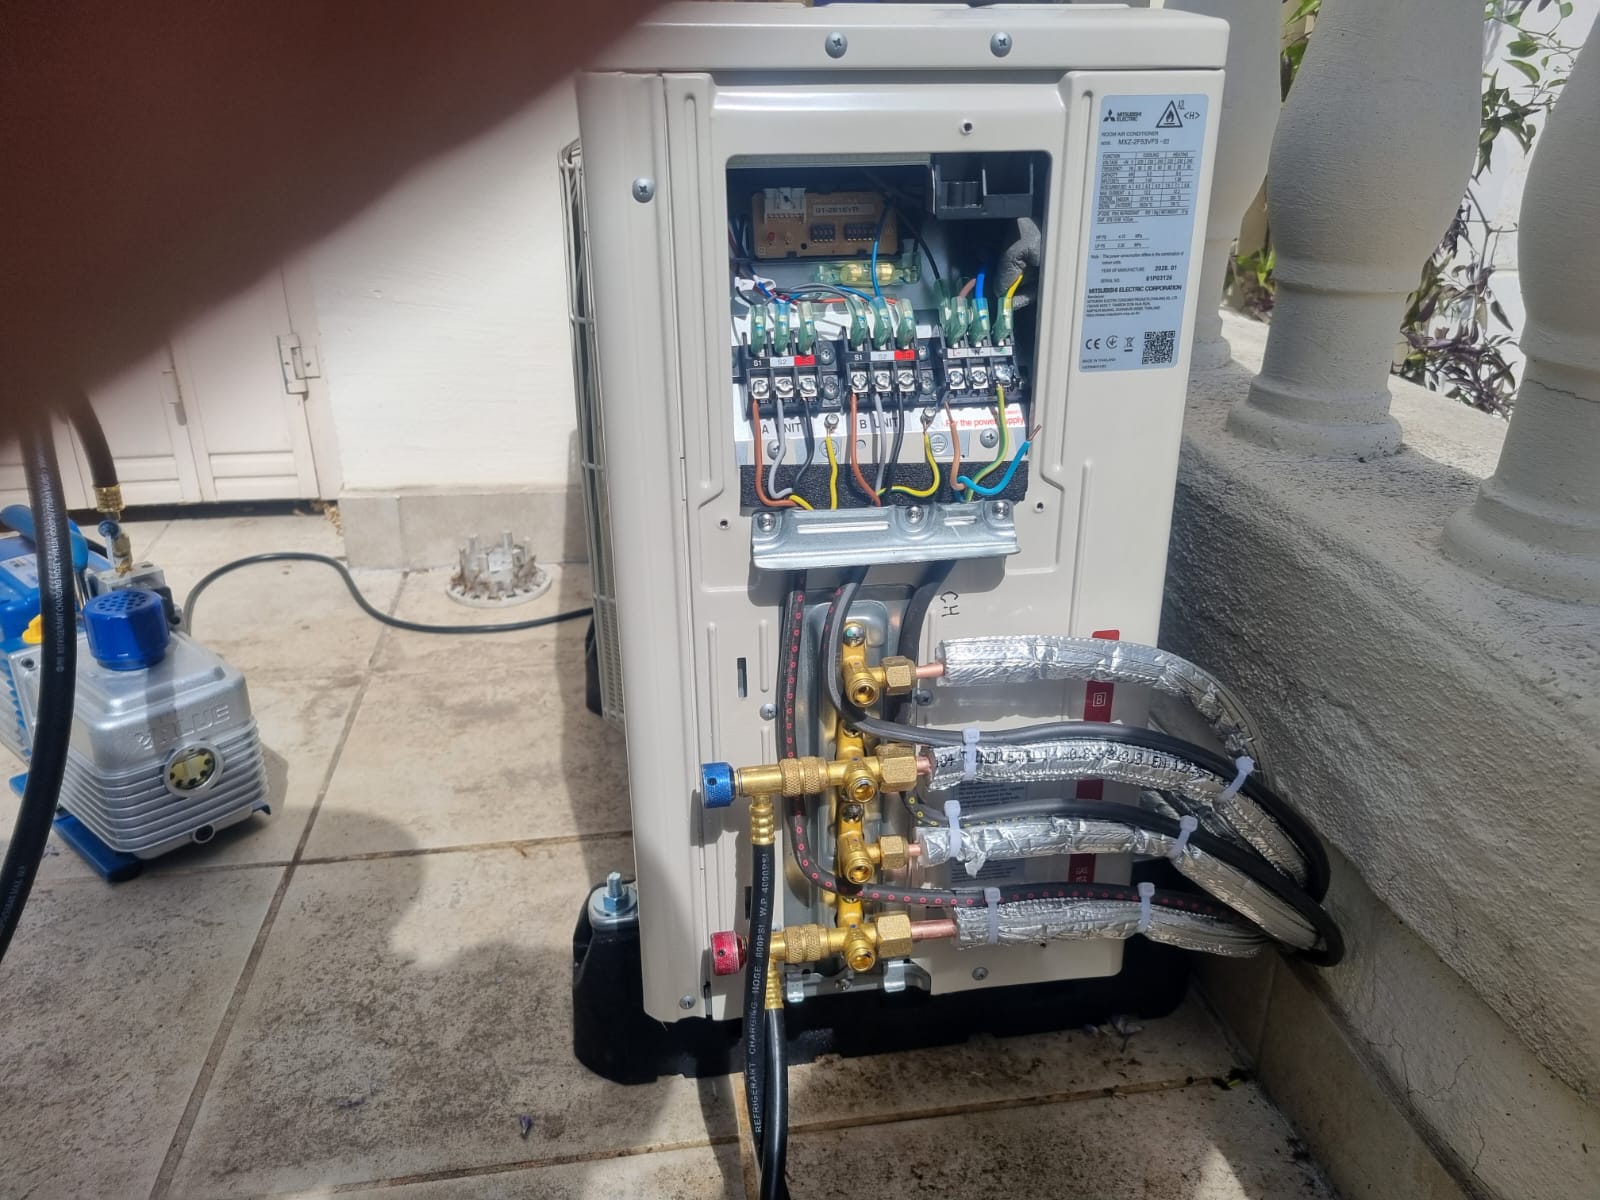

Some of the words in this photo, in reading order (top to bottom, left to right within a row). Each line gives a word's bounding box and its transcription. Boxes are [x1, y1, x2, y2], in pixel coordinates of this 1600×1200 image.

[762, 424, 769, 434] A
[860, 419, 867, 429] B
[752, 966, 761, 993] HOSE
[749, 1001, 758, 1055] CHARGING
[750, 1062, 761, 1133] REFRIGERANT
